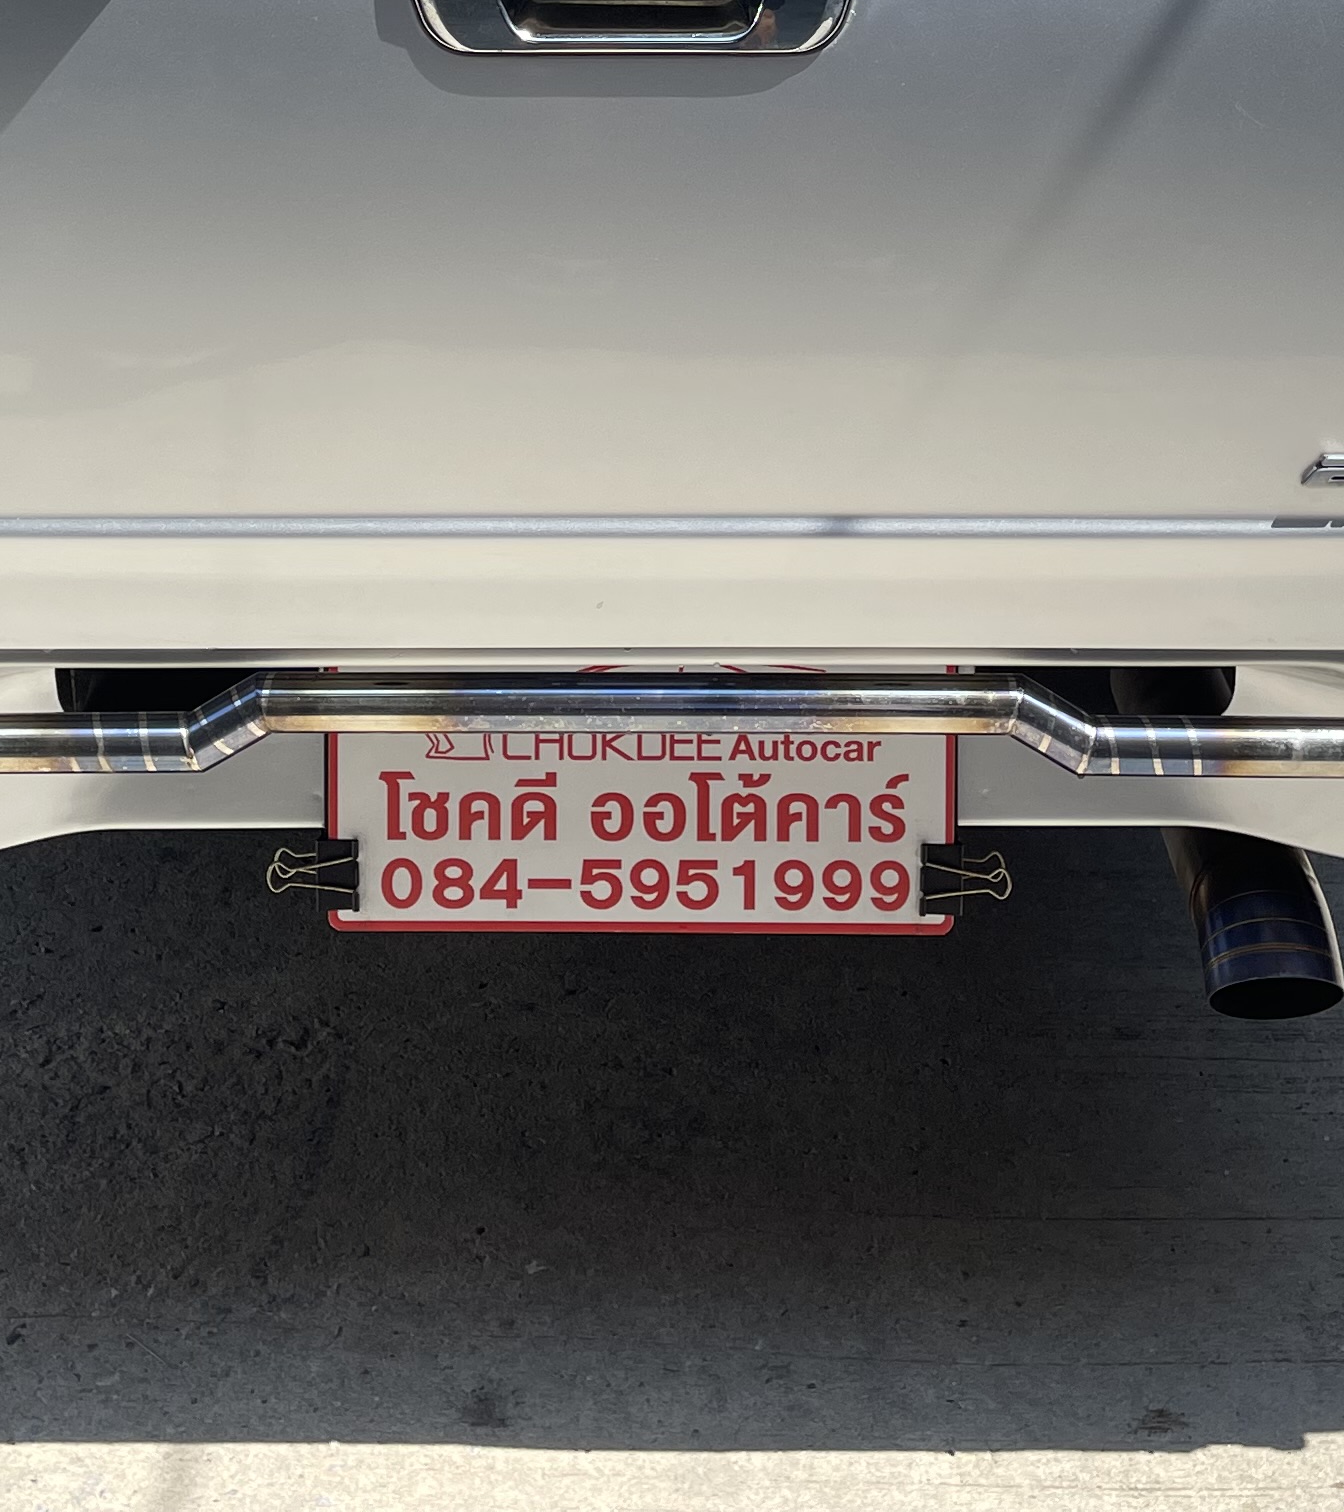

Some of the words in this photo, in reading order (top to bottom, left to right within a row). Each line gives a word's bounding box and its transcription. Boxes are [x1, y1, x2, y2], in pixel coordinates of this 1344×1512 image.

[501, 733, 722, 761] CHOKDEE
[728, 733, 882, 763] Autocar
[379, 771, 559, 844] โชคดี
[590, 771, 910, 844] ออโต้คาร์
[380, 857, 912, 912] 084-5951999
